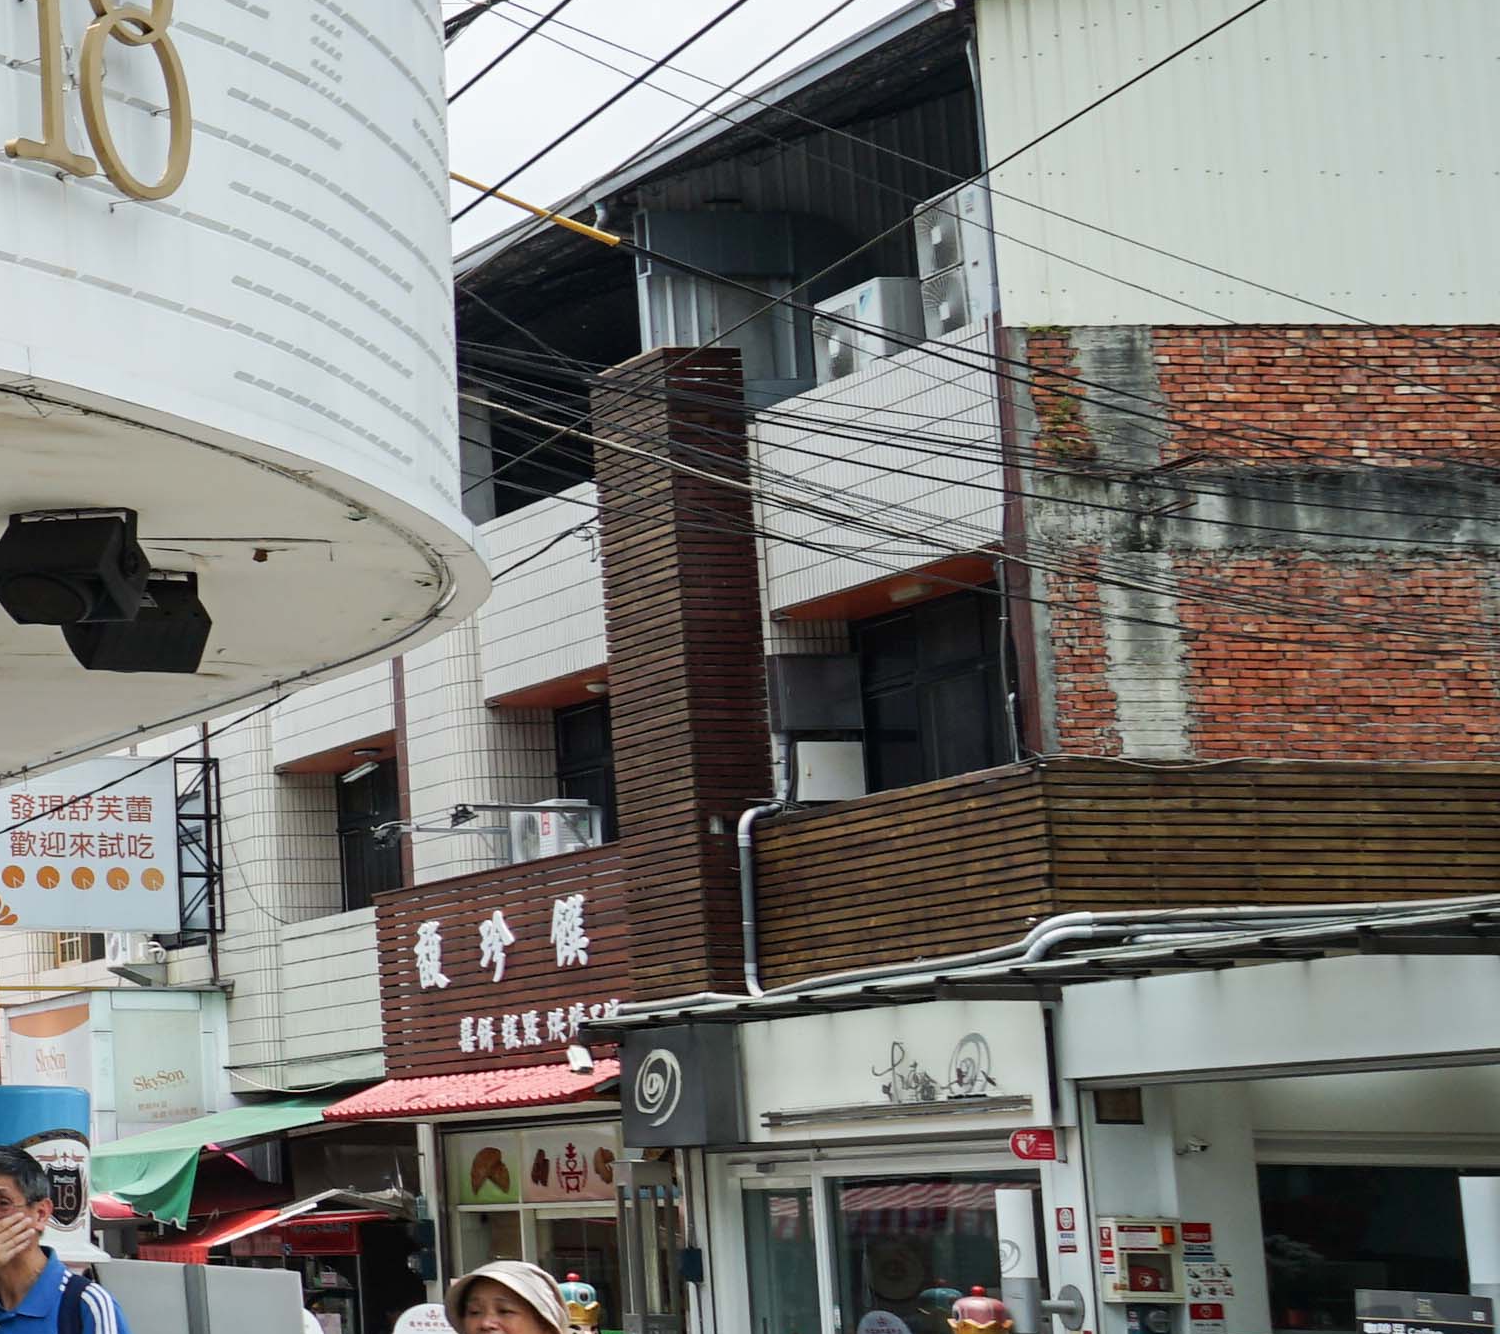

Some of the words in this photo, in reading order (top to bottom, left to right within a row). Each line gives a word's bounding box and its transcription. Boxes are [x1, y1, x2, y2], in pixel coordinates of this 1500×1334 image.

[10, 794, 153, 823] 發現舒芙蕾
[10, 831, 154, 859] 歡迎來試吃
[133, 1068, 185, 1091] SkySon
[53, 1184, 77, 1210] 18
